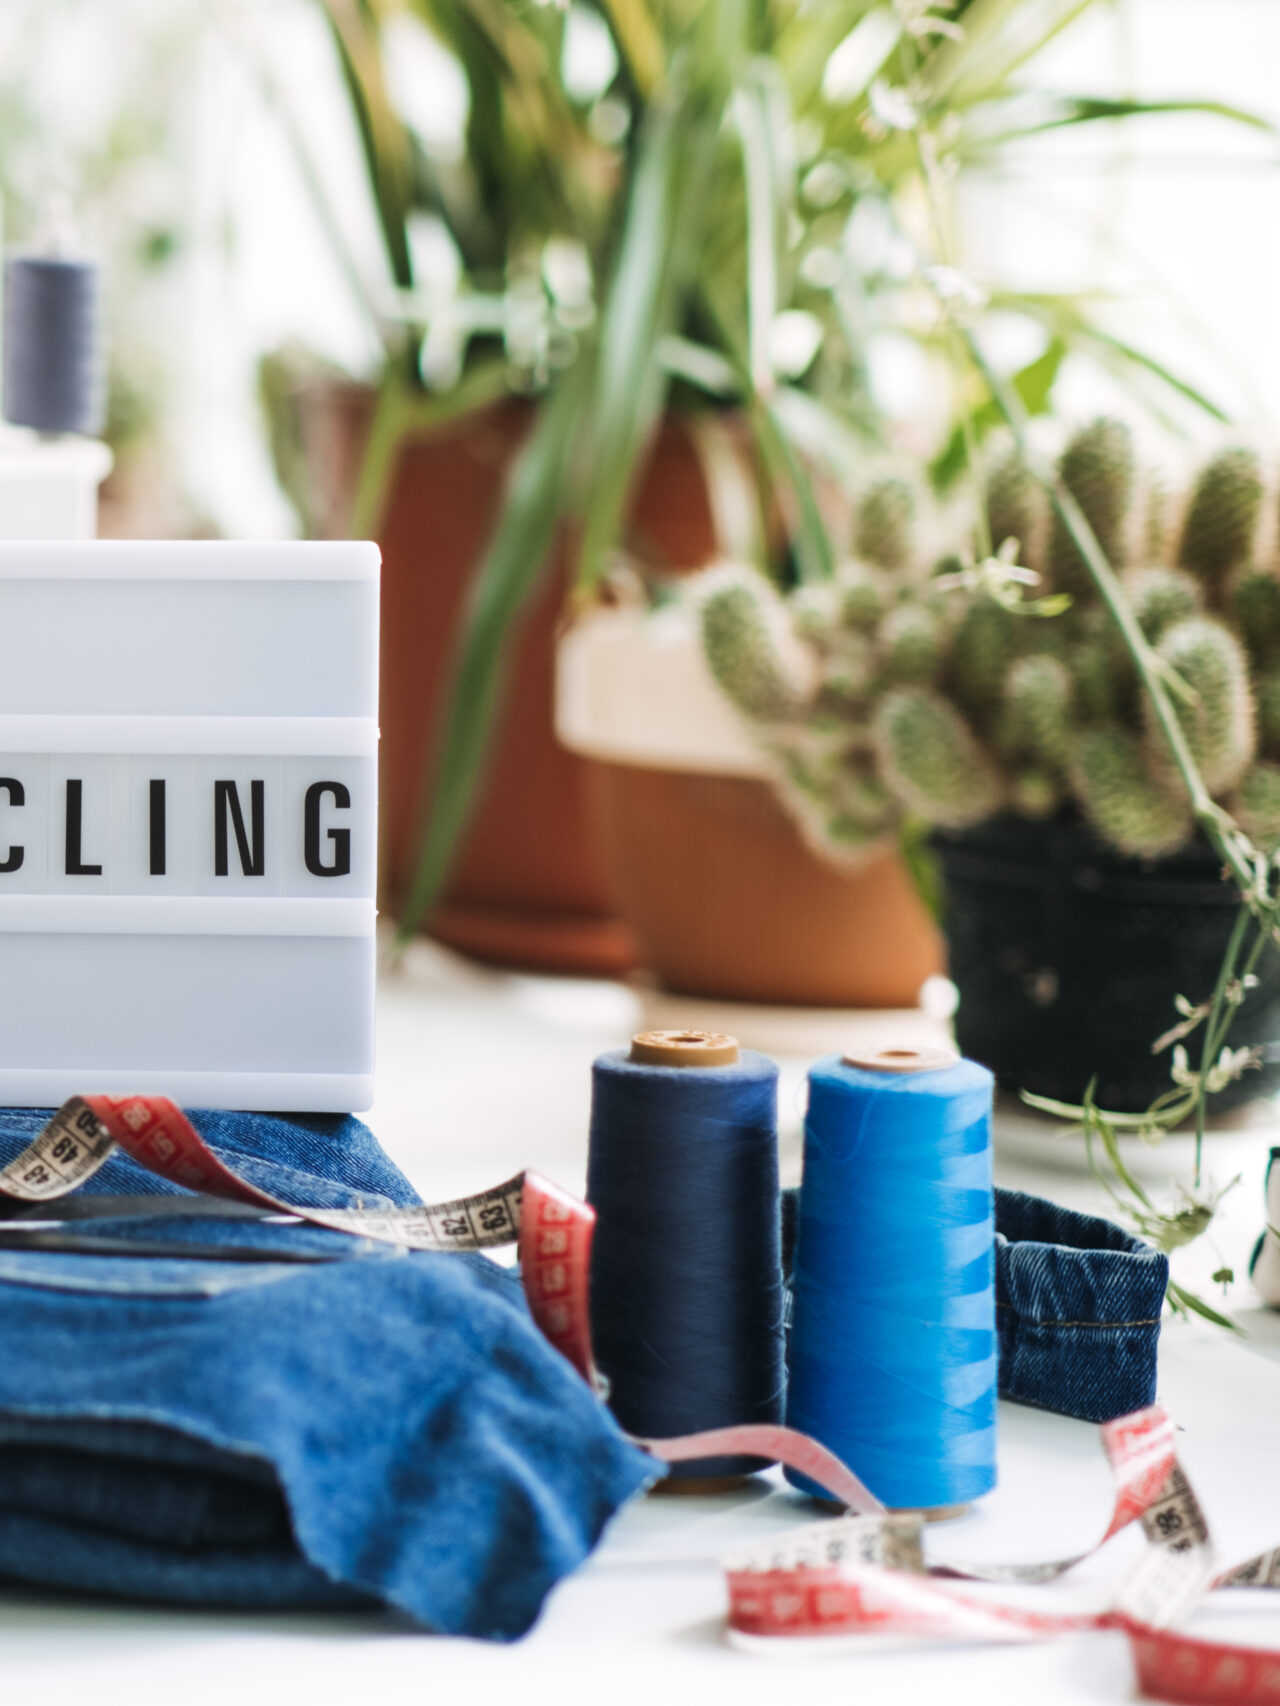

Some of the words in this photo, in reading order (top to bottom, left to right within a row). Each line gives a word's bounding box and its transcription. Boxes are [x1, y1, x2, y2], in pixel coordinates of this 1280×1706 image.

[76, 1109, 100, 1139] 50
[440, 1215, 469, 1235] 62
[479, 1203, 507, 1230] 63
